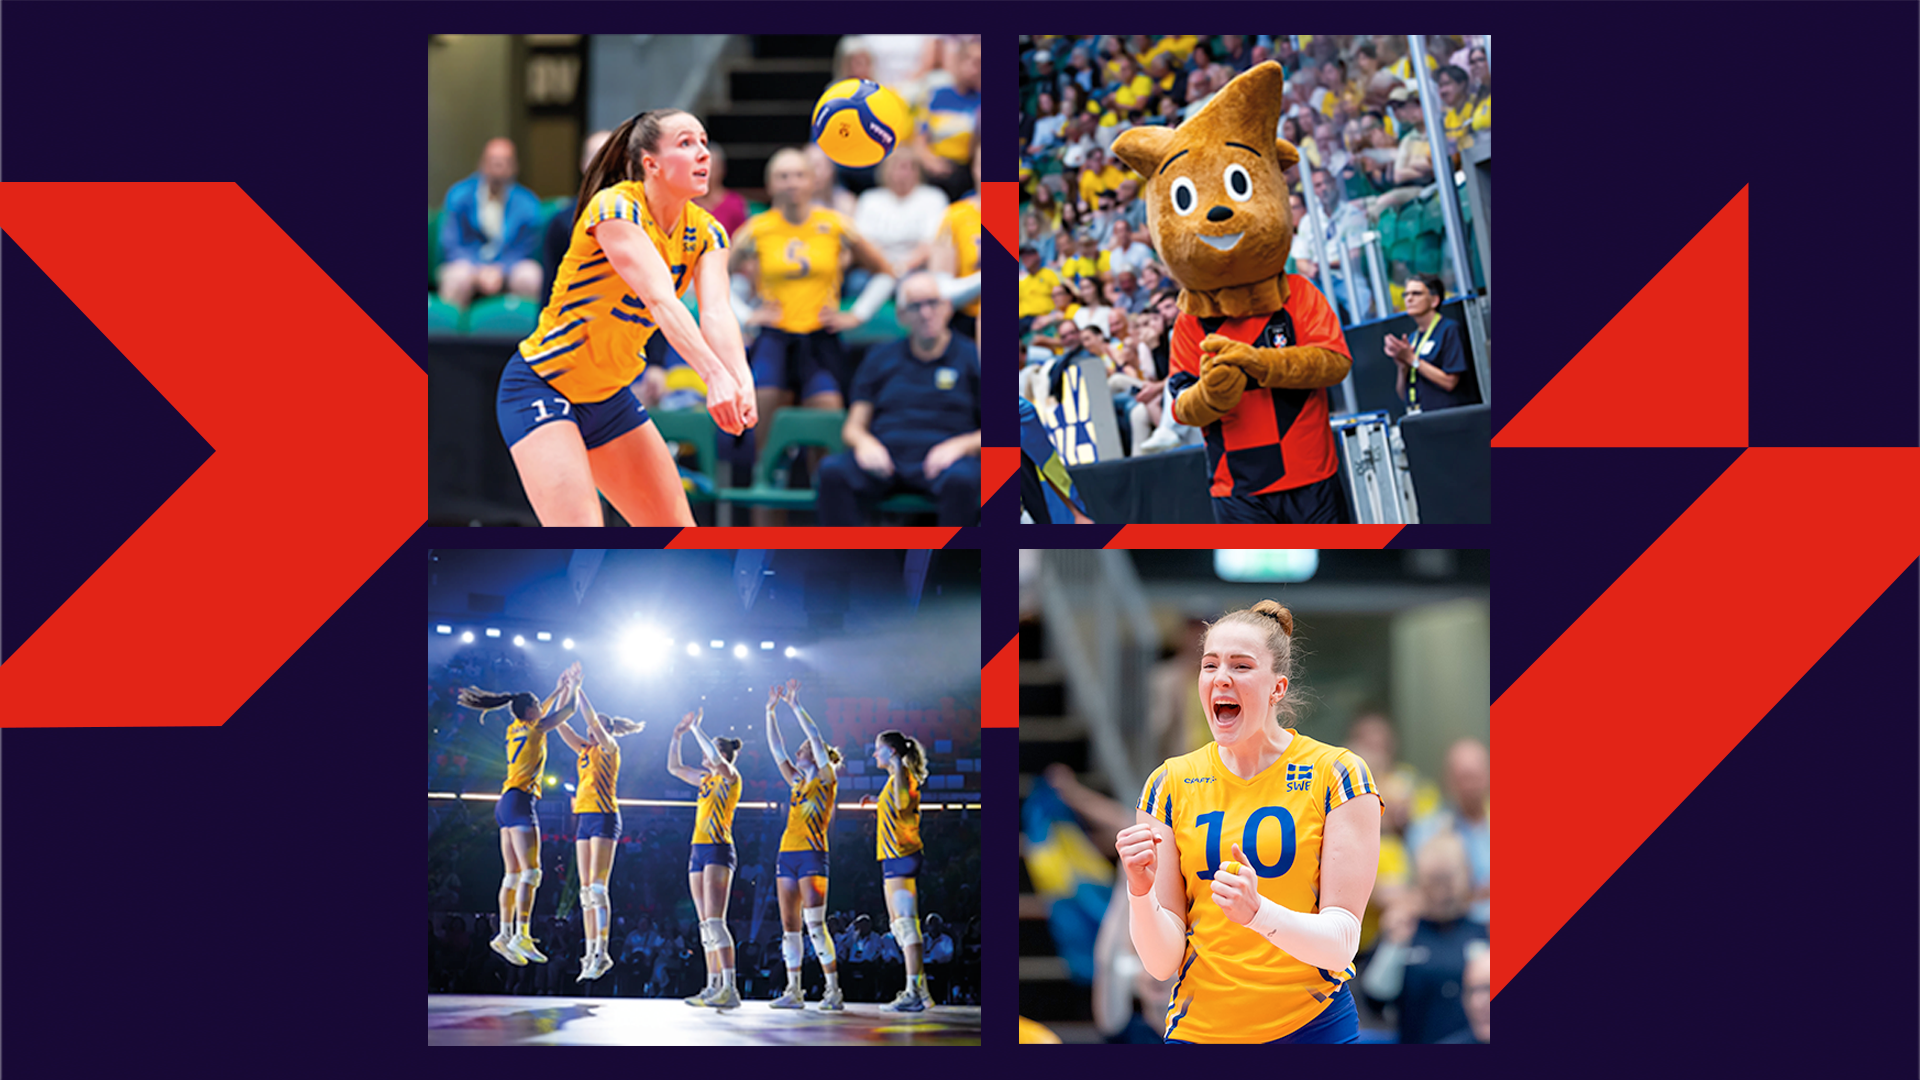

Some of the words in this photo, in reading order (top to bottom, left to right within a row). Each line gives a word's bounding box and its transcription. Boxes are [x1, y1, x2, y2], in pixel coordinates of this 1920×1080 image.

[531, 398, 571, 422] 17
[1286, 780, 1311, 793] SWE
[1195, 805, 1297, 880] 10
